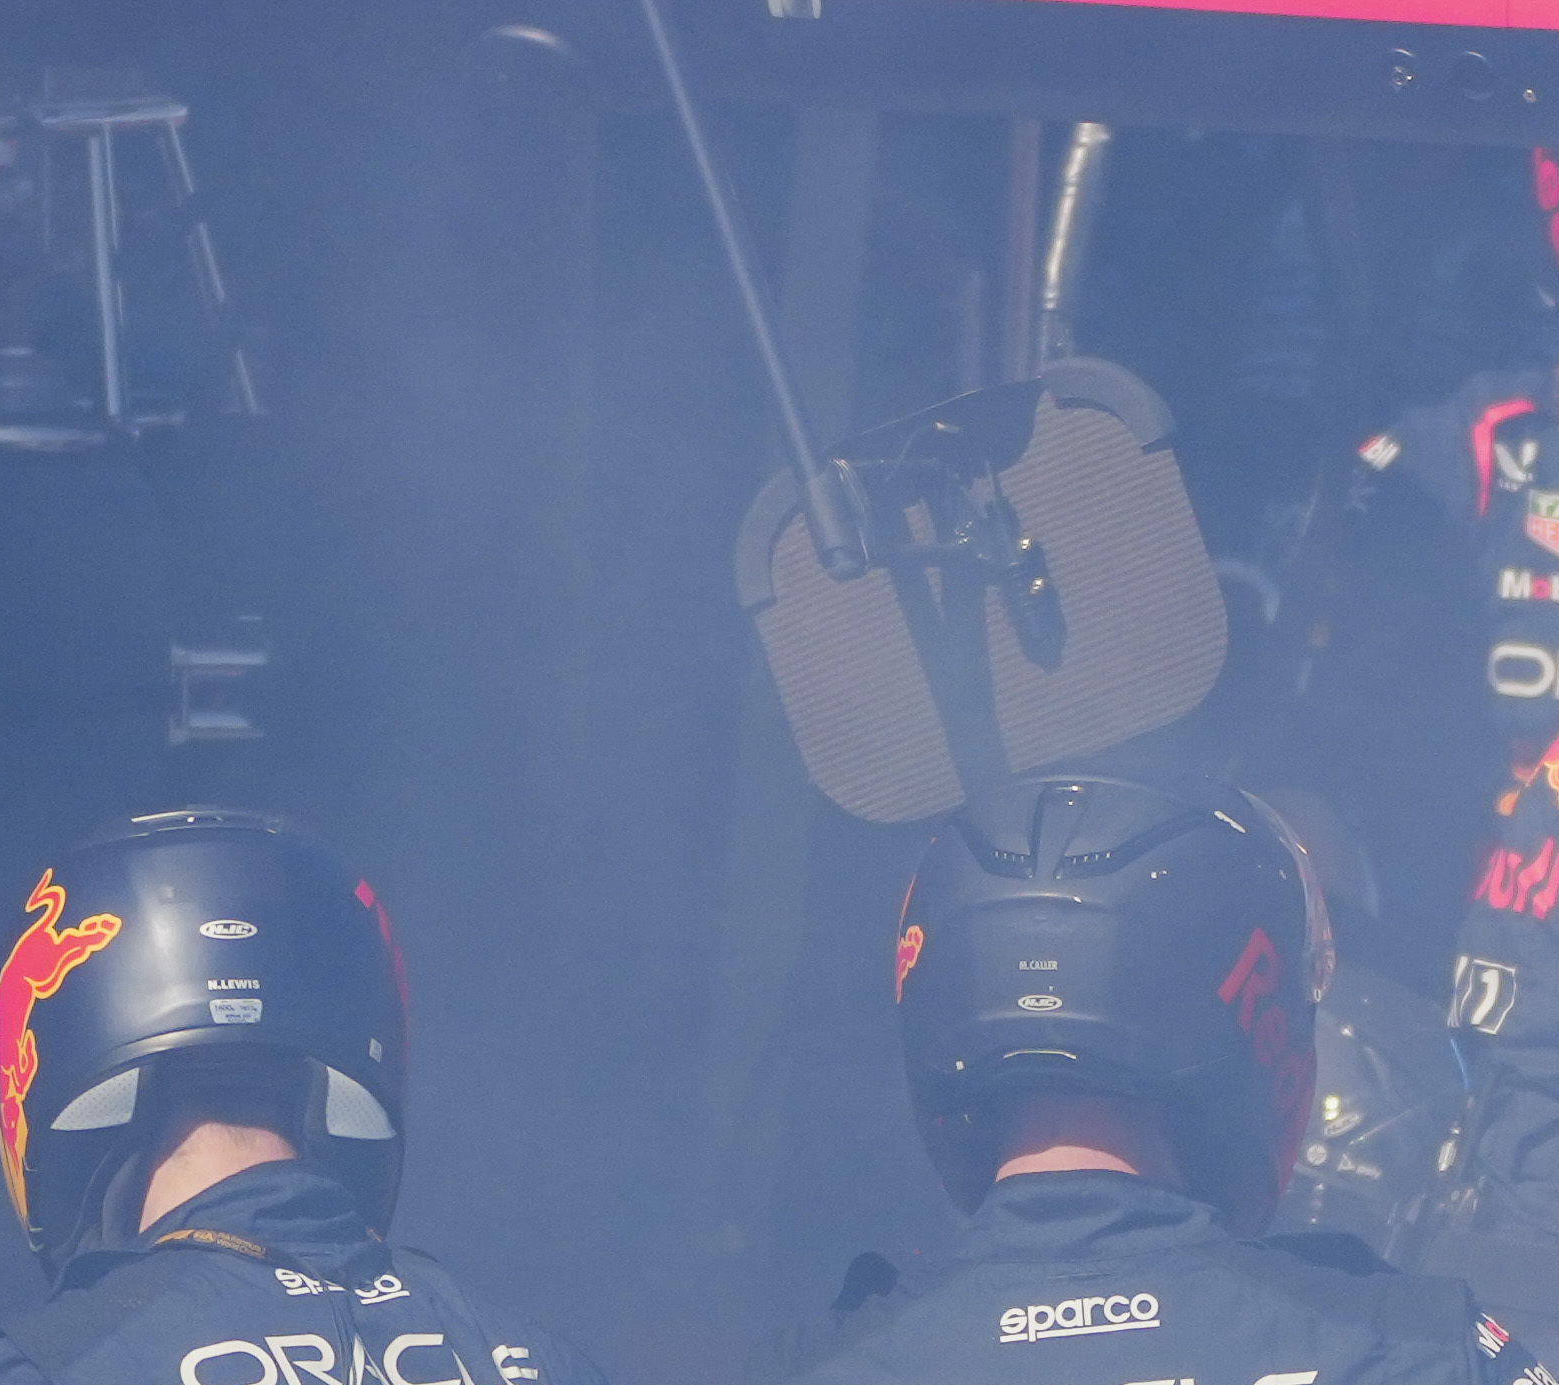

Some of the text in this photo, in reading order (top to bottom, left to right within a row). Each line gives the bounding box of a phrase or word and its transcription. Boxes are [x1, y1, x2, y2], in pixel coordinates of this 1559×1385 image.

[205, 922, 251, 938] HJC
[1018, 960, 1059, 972] M.CALLER
[206, 979, 261, 991] N.LEWIS
[274, 1267, 411, 1305] spco
[999, 1293, 1161, 1342] sparco
